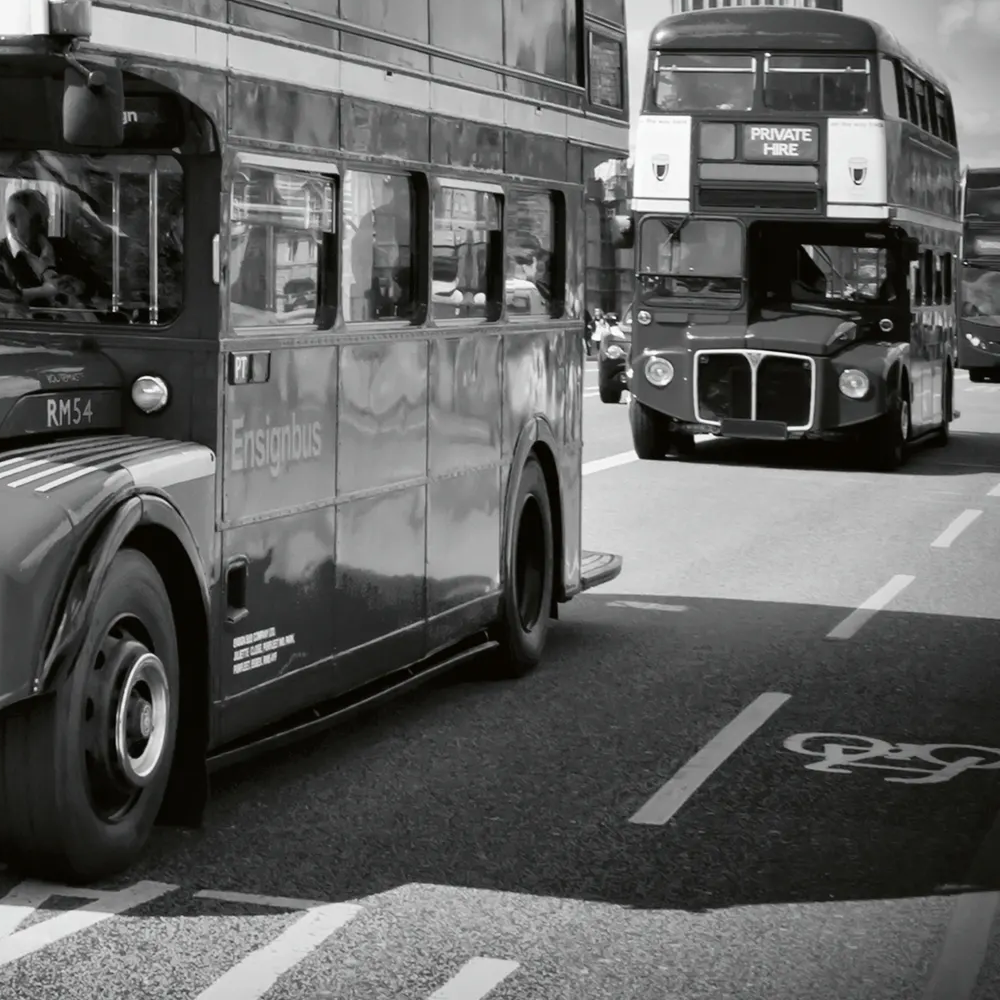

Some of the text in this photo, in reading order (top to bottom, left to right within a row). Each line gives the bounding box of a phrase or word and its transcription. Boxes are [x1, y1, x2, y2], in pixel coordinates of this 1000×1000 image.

[751, 127, 812, 142] PRIVATE
[763, 143, 799, 156] HIRE
[47, 397, 93, 427] RM54
[231, 411, 321, 477] Ensignbus
